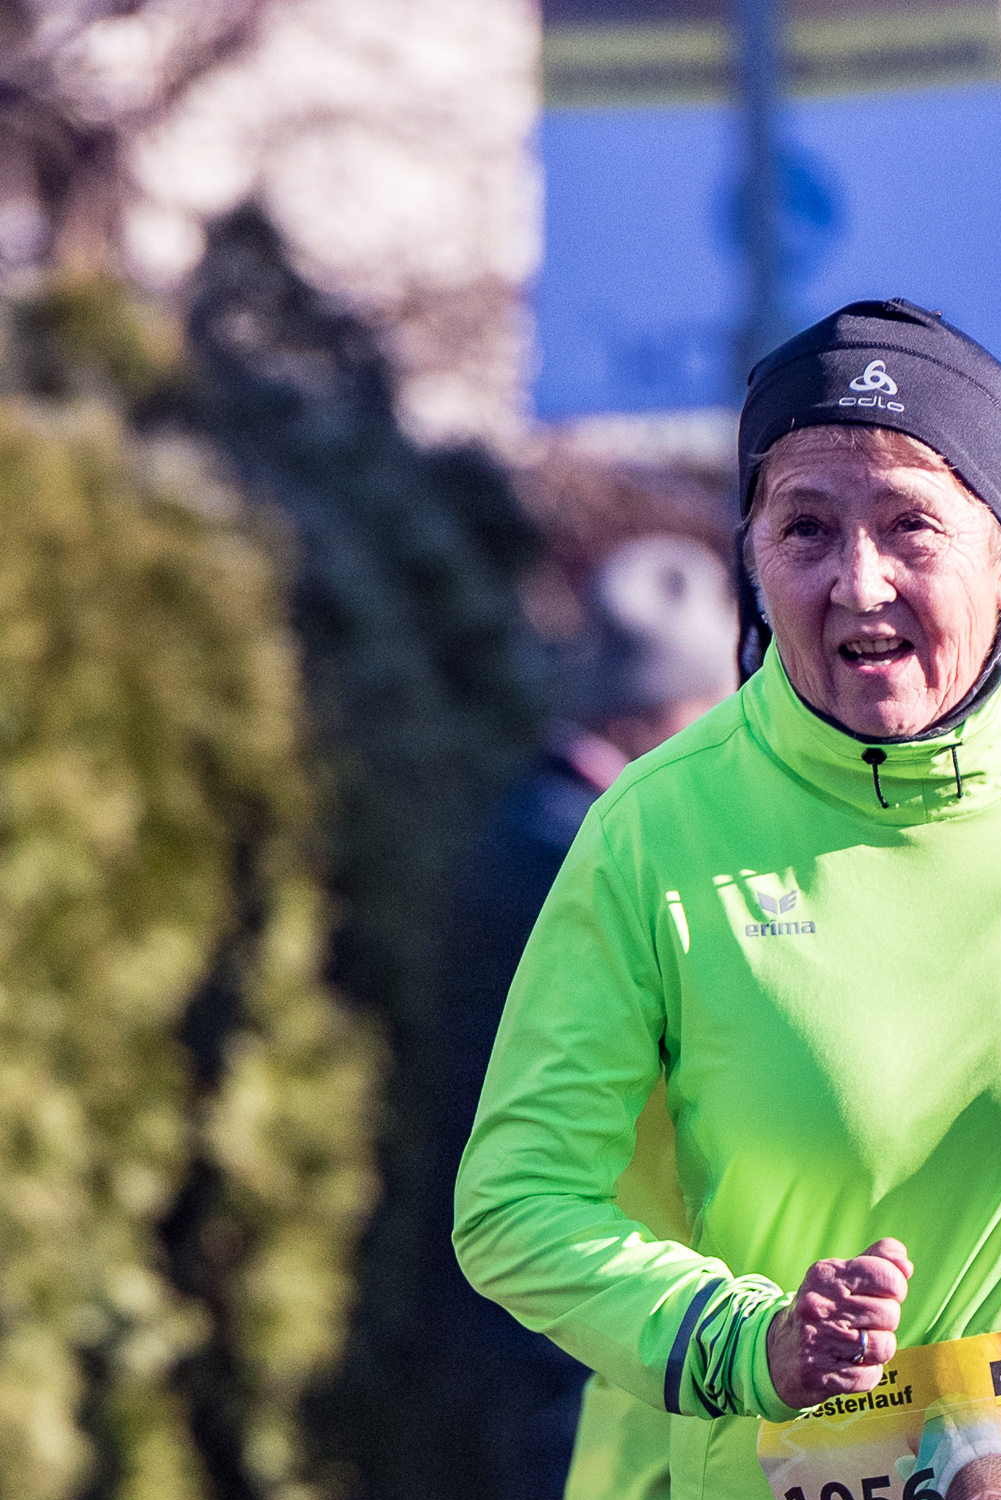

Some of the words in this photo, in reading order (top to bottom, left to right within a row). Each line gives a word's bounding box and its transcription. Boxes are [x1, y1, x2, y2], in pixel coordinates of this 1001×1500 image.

[838, 395, 905, 412] odlo
[745, 919, 816, 937] erima
[803, 1385, 913, 1419] esterlauf
